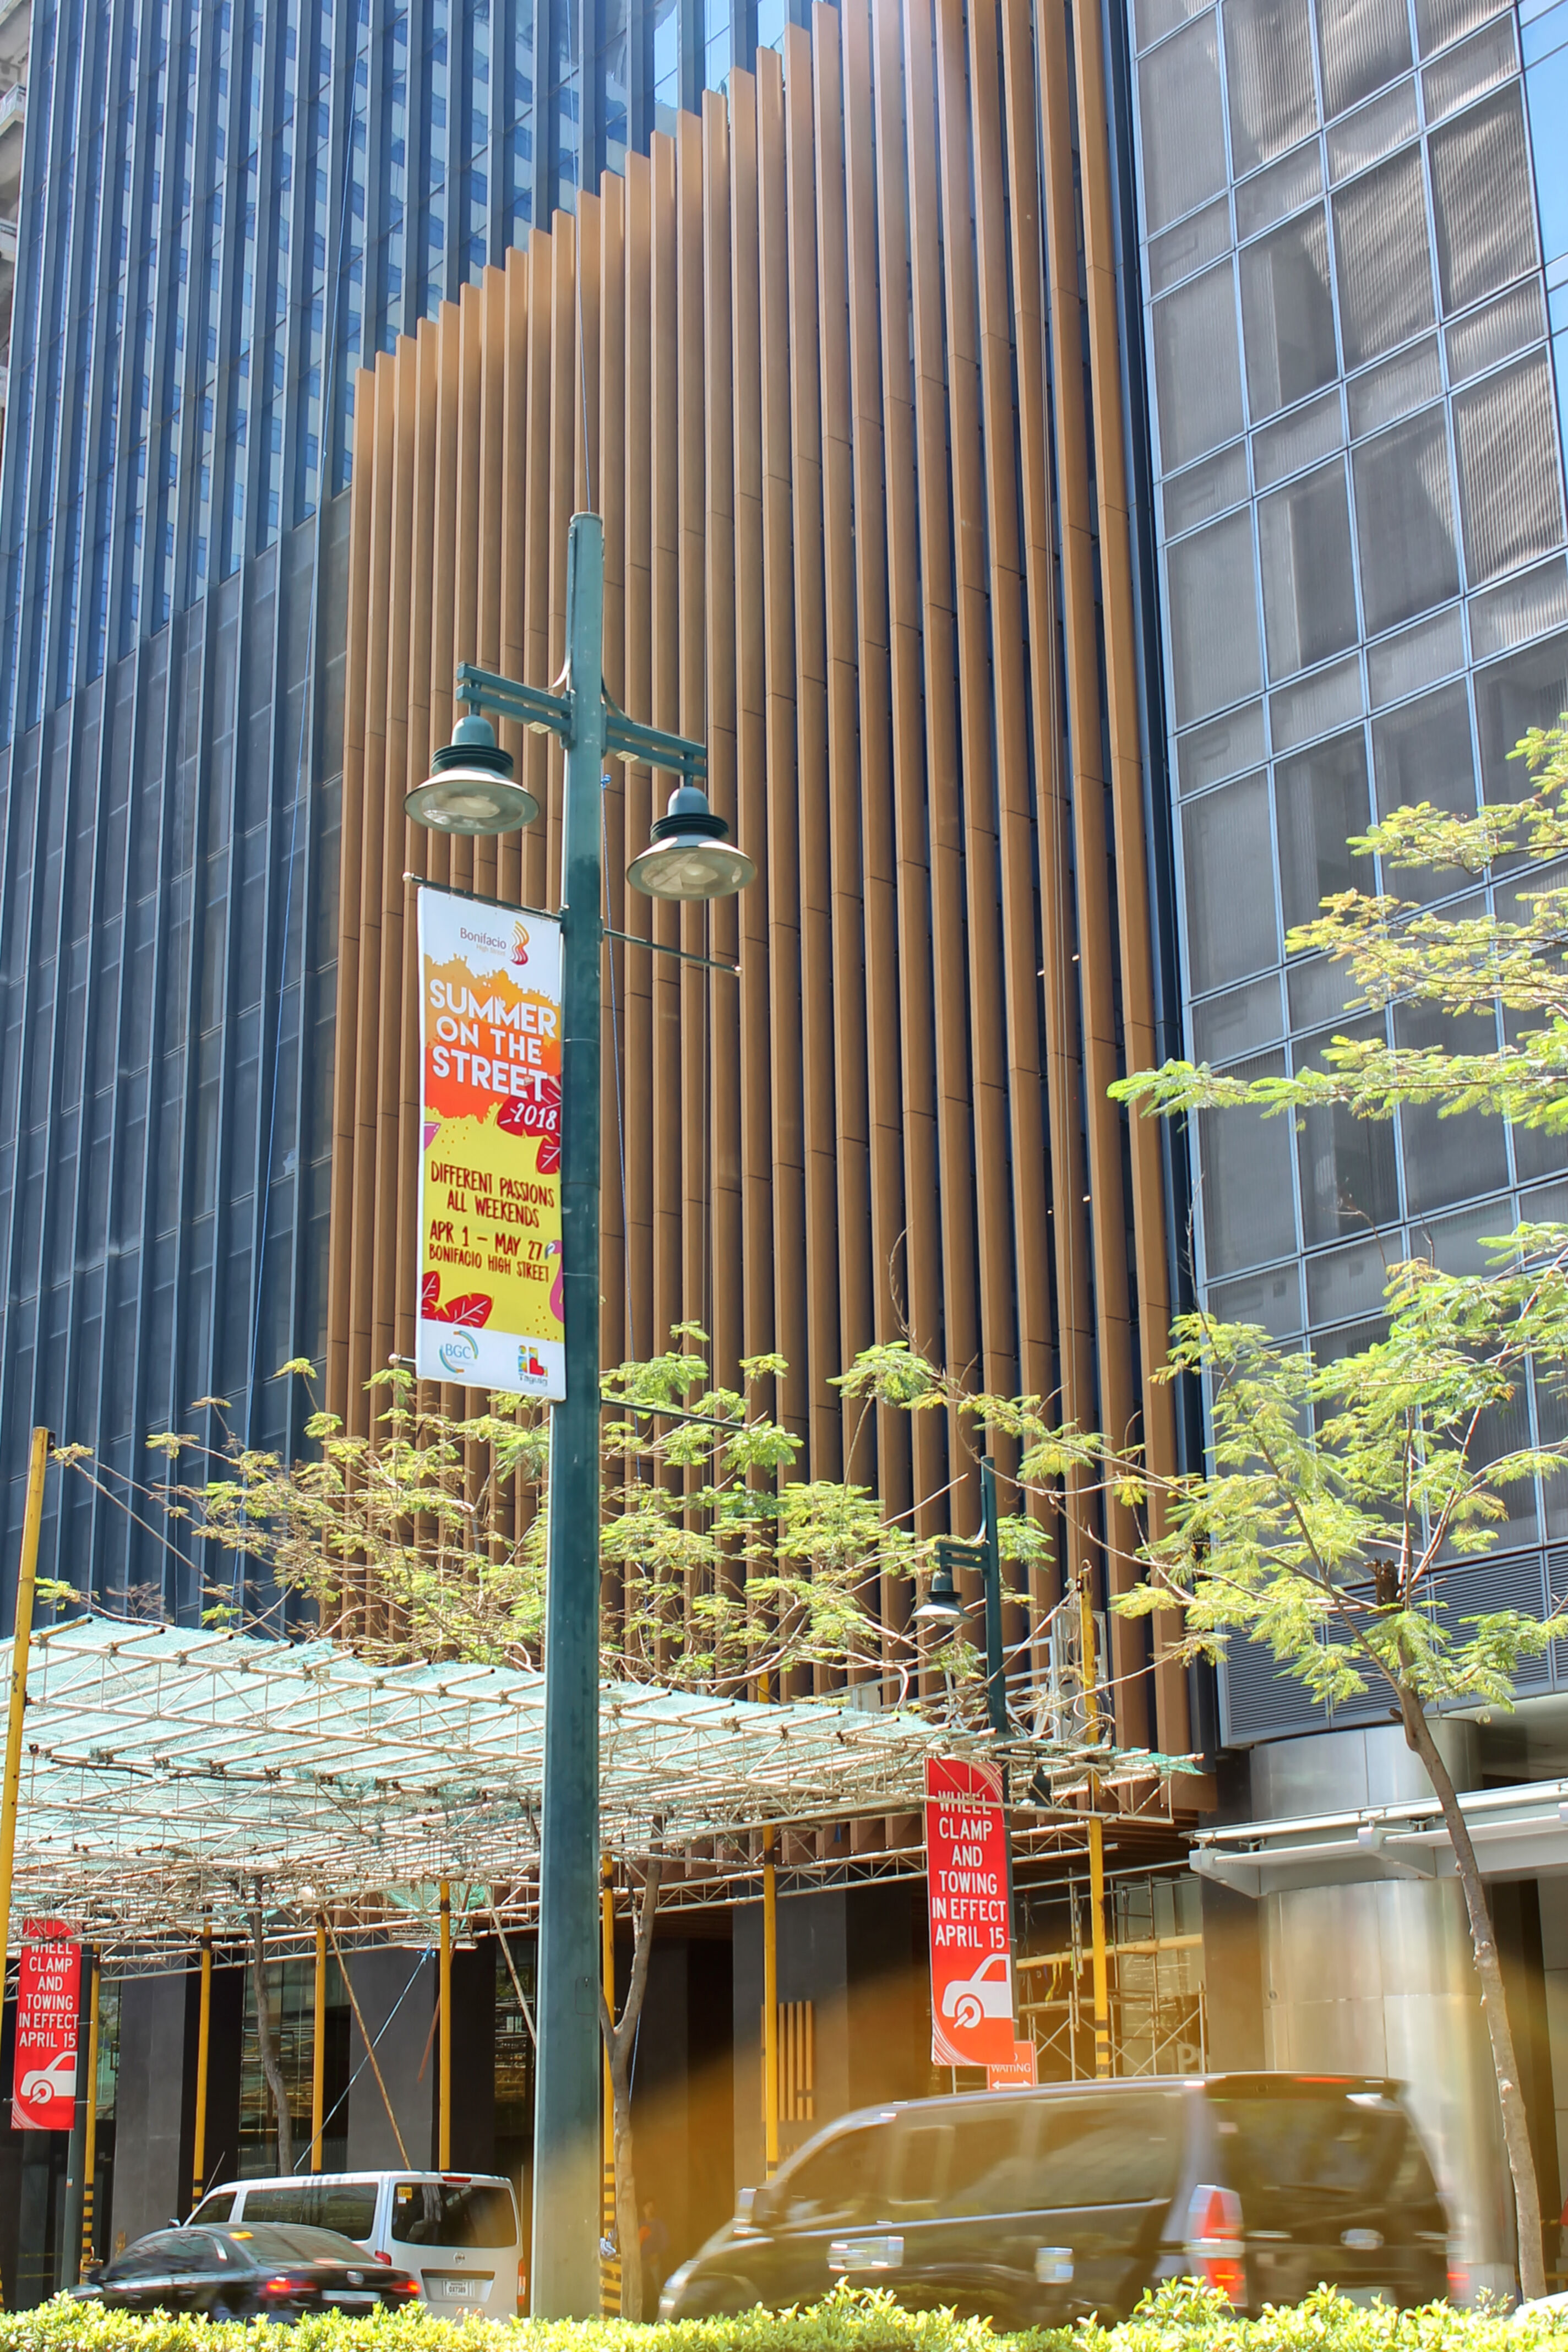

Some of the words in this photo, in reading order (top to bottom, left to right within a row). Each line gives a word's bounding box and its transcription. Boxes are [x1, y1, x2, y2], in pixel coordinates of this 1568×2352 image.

[460, 927, 507, 949] Bonifacio
[429, 979, 557, 1038] SUMMER
[436, 1016, 479, 1049] ON
[489, 1027, 542, 1065] THE
[432, 1045, 548, 1103] STREET
[513, 1102, 558, 1131] 2018
[431, 1160, 492, 1195] DIFFERENT
[499, 1177, 554, 1208] PASSIONS
[447, 1189, 467, 1212] ALL
[475, 1195, 540, 1228] WEEKENDS
[429, 1219, 454, 1244] APR
[462, 1225, 469, 1247] 1
[495, 1232, 521, 1257] MAY
[528, 1239, 543, 1261] 27
[429, 1243, 482, 1269] BONIFACIO
[488, 1253, 511, 1275] HIGH
[516, 1260, 549, 1283] STREET
[445, 1343, 471, 1359] BGC
[938, 1790, 992, 1815] WHEEL
[939, 1816, 993, 1841] CLAMP
[951, 1844, 983, 1868] AND
[939, 1870, 998, 1895] TOWING
[932, 1897, 947, 1919] IN
[950, 1898, 1006, 1922] EFFECT
[935, 1924, 983, 1948] APRIL
[989, 1926, 1005, 1949] 15
[29, 1956, 73, 1973] CLAMP
[37, 1975, 63, 1991] AND
[26, 1994, 73, 2011] TOWING
[19, 2012, 31, 2028] IN
[33, 2013, 79, 2029] EFFECT
[19, 2031, 58, 2048] APRIL
[63, 2032, 76, 2048] 15
